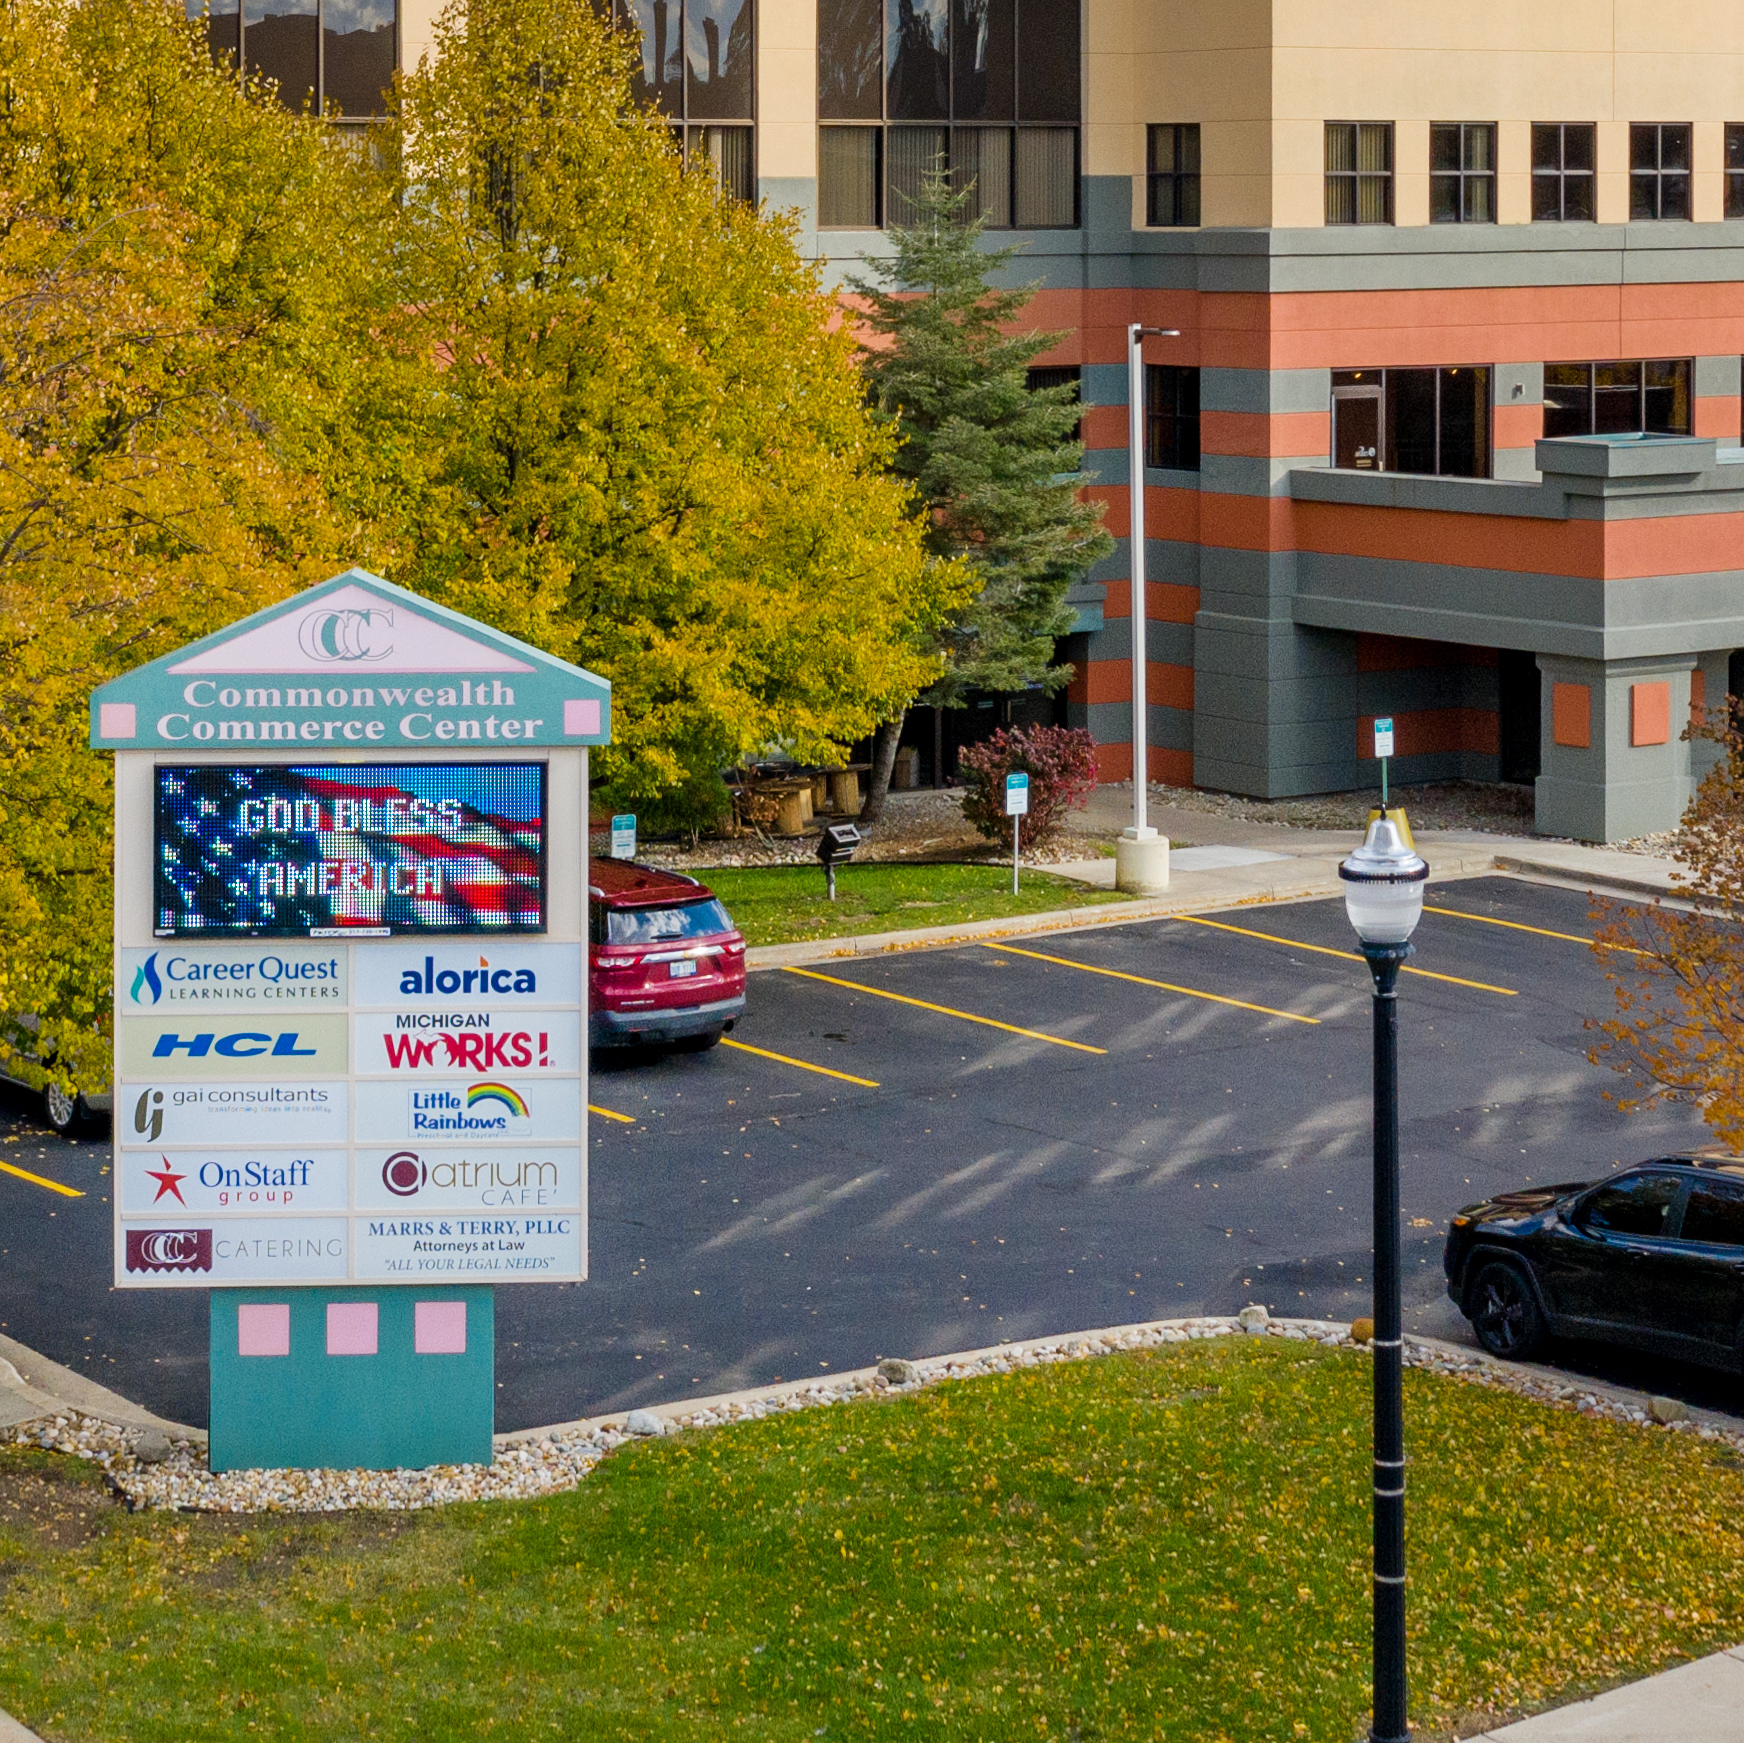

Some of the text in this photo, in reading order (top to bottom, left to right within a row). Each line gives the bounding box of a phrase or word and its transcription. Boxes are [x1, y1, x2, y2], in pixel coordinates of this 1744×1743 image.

[183, 680, 515, 708] Commonwealth
[156, 713, 544, 740] Commerce Center
[239, 797, 463, 833] GOD BLESS
[258, 860, 443, 897] AMERICA
[399, 954, 536, 995] alorica
[169, 986, 339, 999] LEARNING CENTERS
[396, 1013, 490, 1028] MICHIGAN
[152, 1032, 317, 1057] HCL
[383, 1031, 549, 1073] WORKS!
[172, 1087, 329, 1106] gai consultants
[413, 1091, 461, 1109] Little
[261, 1104, 281, 1113] ideas
[284, 1104, 300, 1113] into
[413, 1111, 507, 1130] Rainbows
[431, 1159, 558, 1187] atrium
[218, 1189, 294, 1206] group
[368, 1219, 571, 1238] MARRS & TERRY, PLLC
[215, 1238, 343, 1259] CATERING
[413, 1239, 526, 1254] Attorneys at Law
[418, 1258, 455, 1271] YOUR
[458, 1257, 502, 1270] LEGAL
